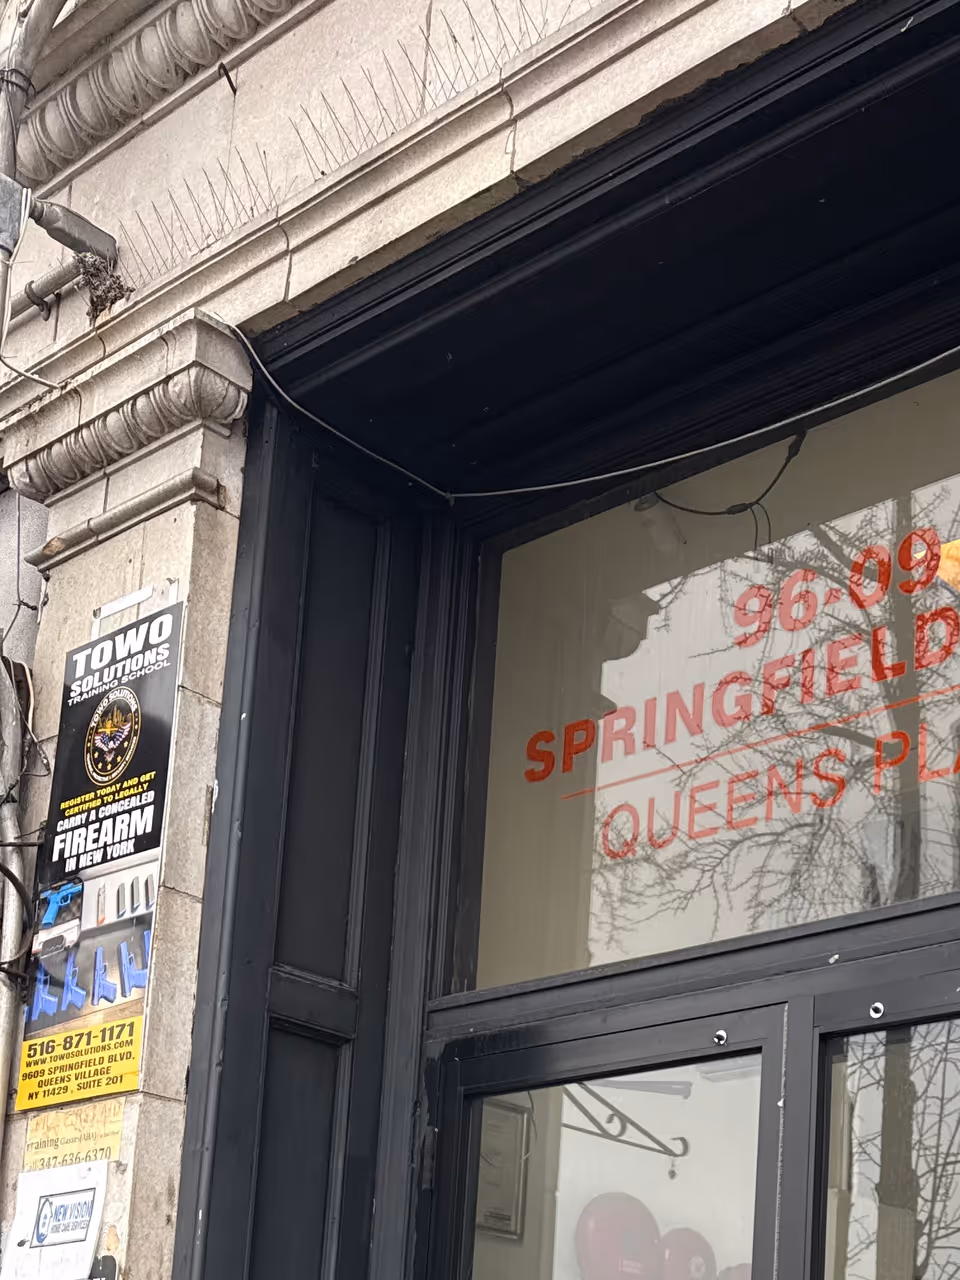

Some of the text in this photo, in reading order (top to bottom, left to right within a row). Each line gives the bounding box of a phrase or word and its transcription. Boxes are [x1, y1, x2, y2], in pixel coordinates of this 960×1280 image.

[733, 525, 942, 648] 96-09
[72, 613, 174, 679] TOWO
[67, 659, 171, 707] TRAINING SCHOOL
[69, 642, 170, 698] SOLUTIONS
[91, 699, 109, 728] TOWO
[60, 770, 157, 810] REGISTER TODAY AND GET
[64, 783, 149, 817] CERTIFIED TO LEGALLY
[600, 748, 848, 860] QUEENS
[56, 790, 155, 832] CARRY A CONCEALED
[52, 804, 155, 862] FIREARM
[65, 838, 136, 873] IN NEW YORK
[25, 1038, 133, 1068] WWW.TOWOSOLUTIONS.COM
[26, 1021, 135, 1059] 516-871-1171
[21, 1068, 46, 1082] 9609
[47, 1056, 105, 1076] SPRINGFIELD
[27, 1090, 40, 1101] NY
[42, 1085, 69, 1098] 11429
[76, 1079, 102, 1091] SUITE
[105, 1074, 123, 1086] 201
[37, 1065, 112, 1088] QUEENS VILLAGE
[53, 1204, 69, 1222] NEW
